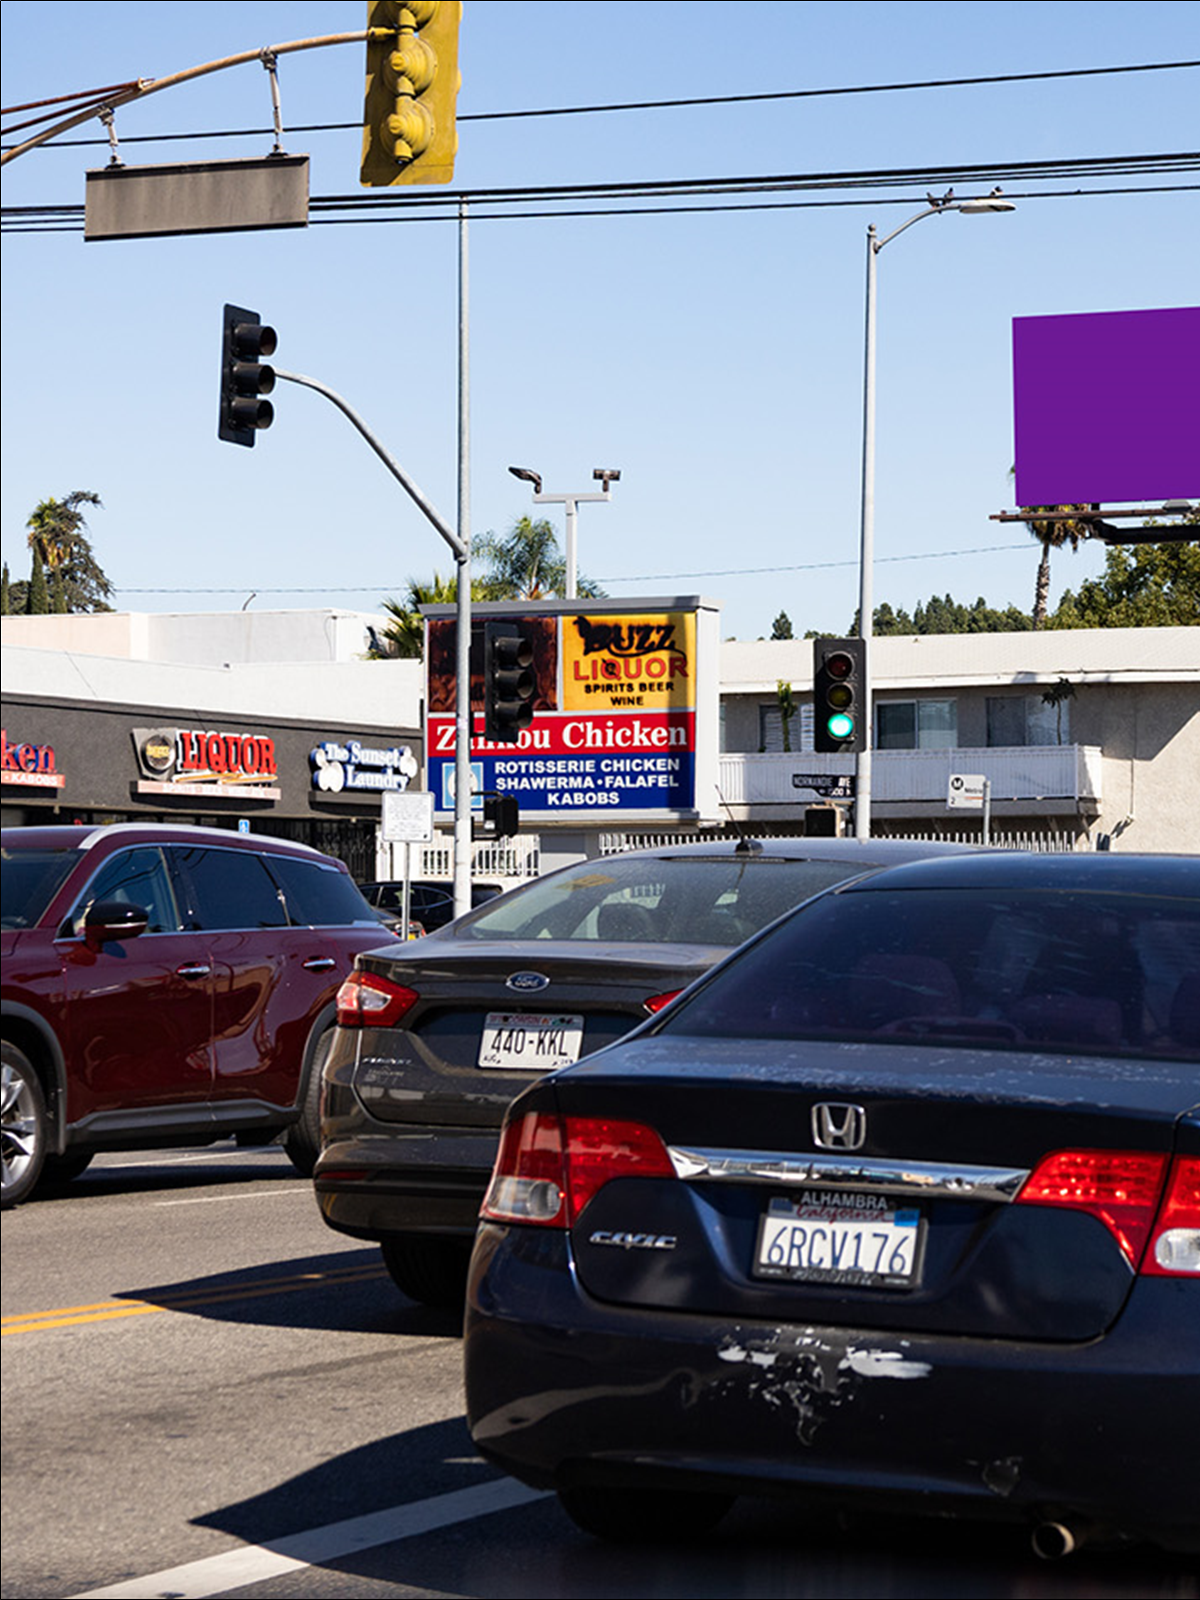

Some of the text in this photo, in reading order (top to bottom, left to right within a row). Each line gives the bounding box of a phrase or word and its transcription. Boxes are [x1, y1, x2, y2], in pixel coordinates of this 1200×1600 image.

[574, 657, 689, 681] LIQUOR
[584, 682, 675, 693] SPIRITS BEER
[610, 696, 644, 706] WINE
[562, 720, 687, 748] Chicken
[180, 732, 277, 775] LIQUOR
[320, 741, 401, 768] The Sunset
[495, 758, 680, 774] ROTISSERIE CHICKEN
[345, 764, 409, 792] Laundry
[496, 775, 679, 790] SHAWERMA FALAFEL
[547, 792, 620, 805] KABOBS
[490, 1028, 567, 1056] 440-KKL
[801, 1191, 888, 1210] ALHAMBRA
[796, 1205, 894, 1224] California
[590, 1231, 676, 1249] CIVIC
[767, 1226, 909, 1275] 6RCV176
